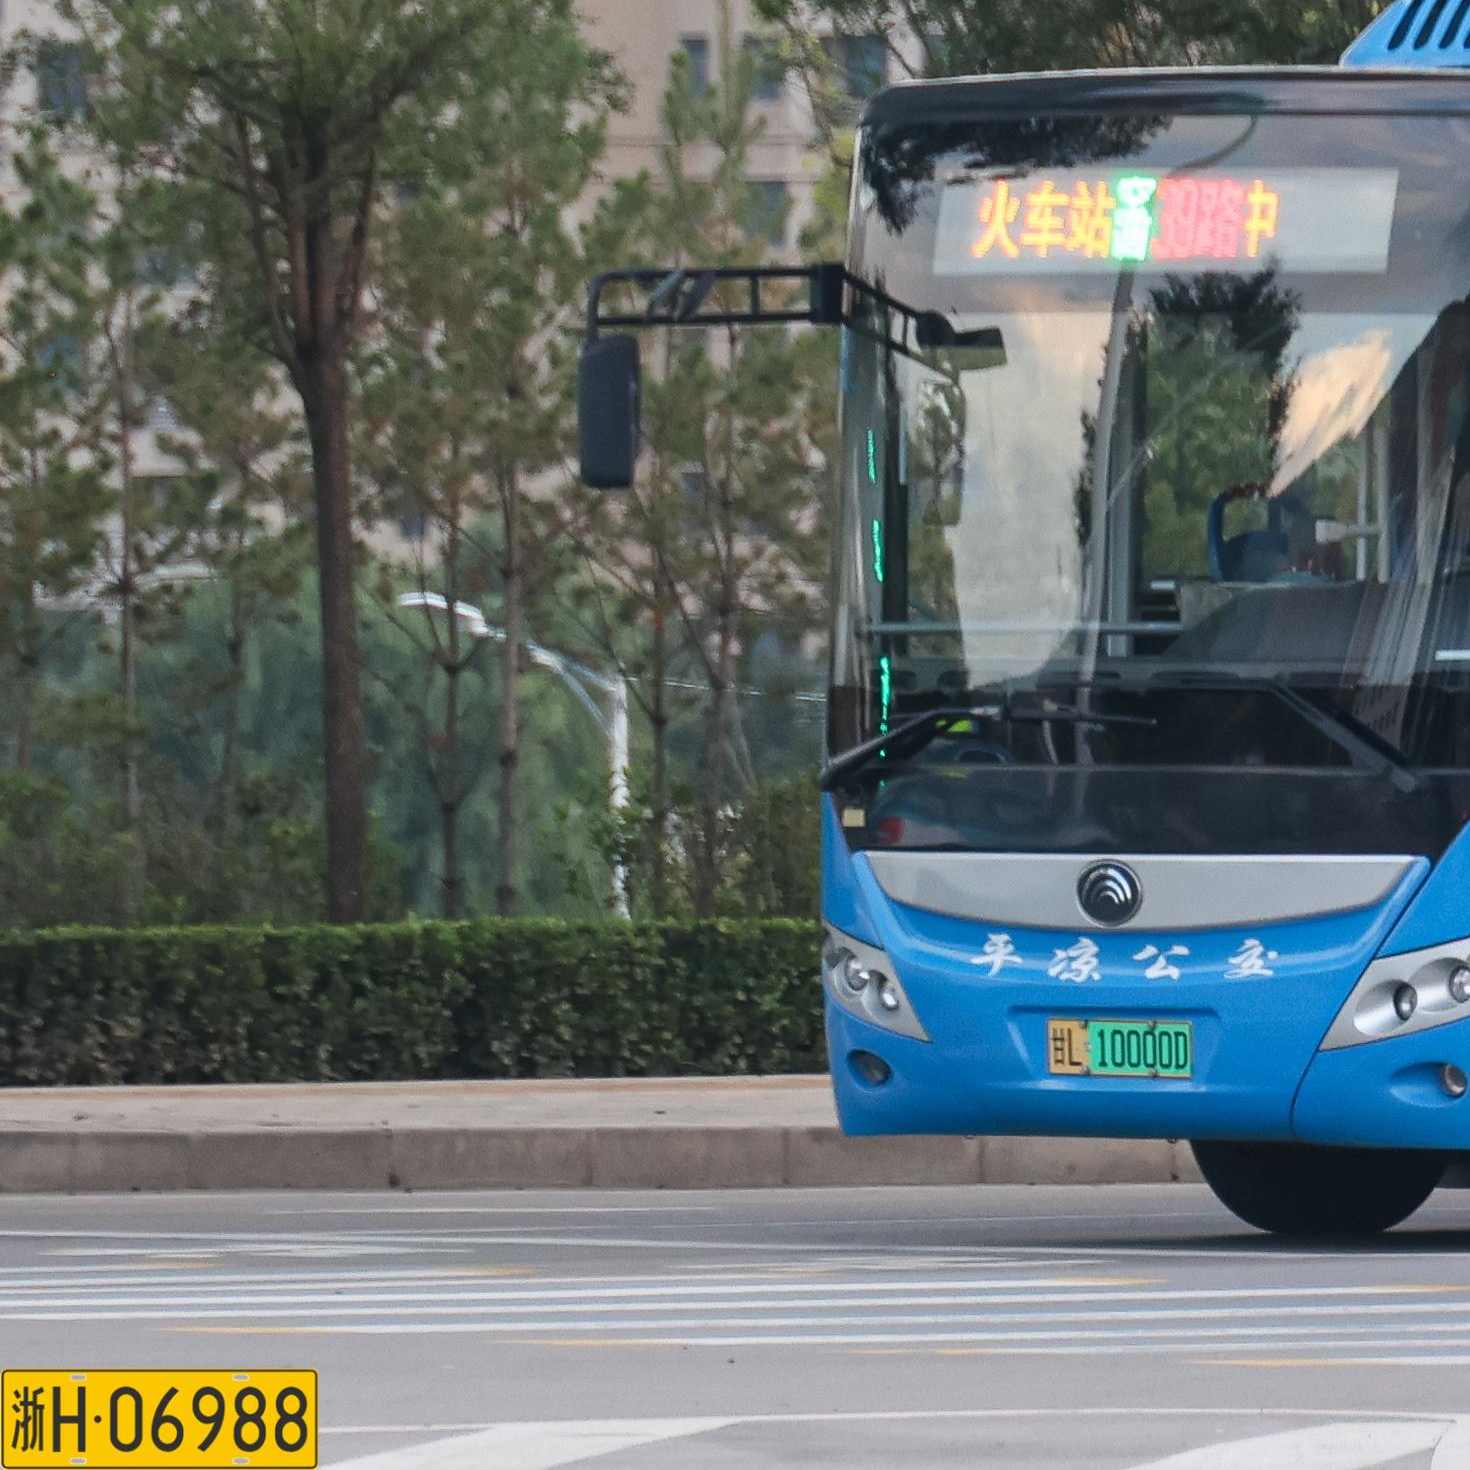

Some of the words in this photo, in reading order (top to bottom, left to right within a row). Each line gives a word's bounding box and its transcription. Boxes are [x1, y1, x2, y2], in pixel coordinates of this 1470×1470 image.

[972, 178, 1116, 259] 火车站
[970, 933, 1276, 983] 平凉公交
